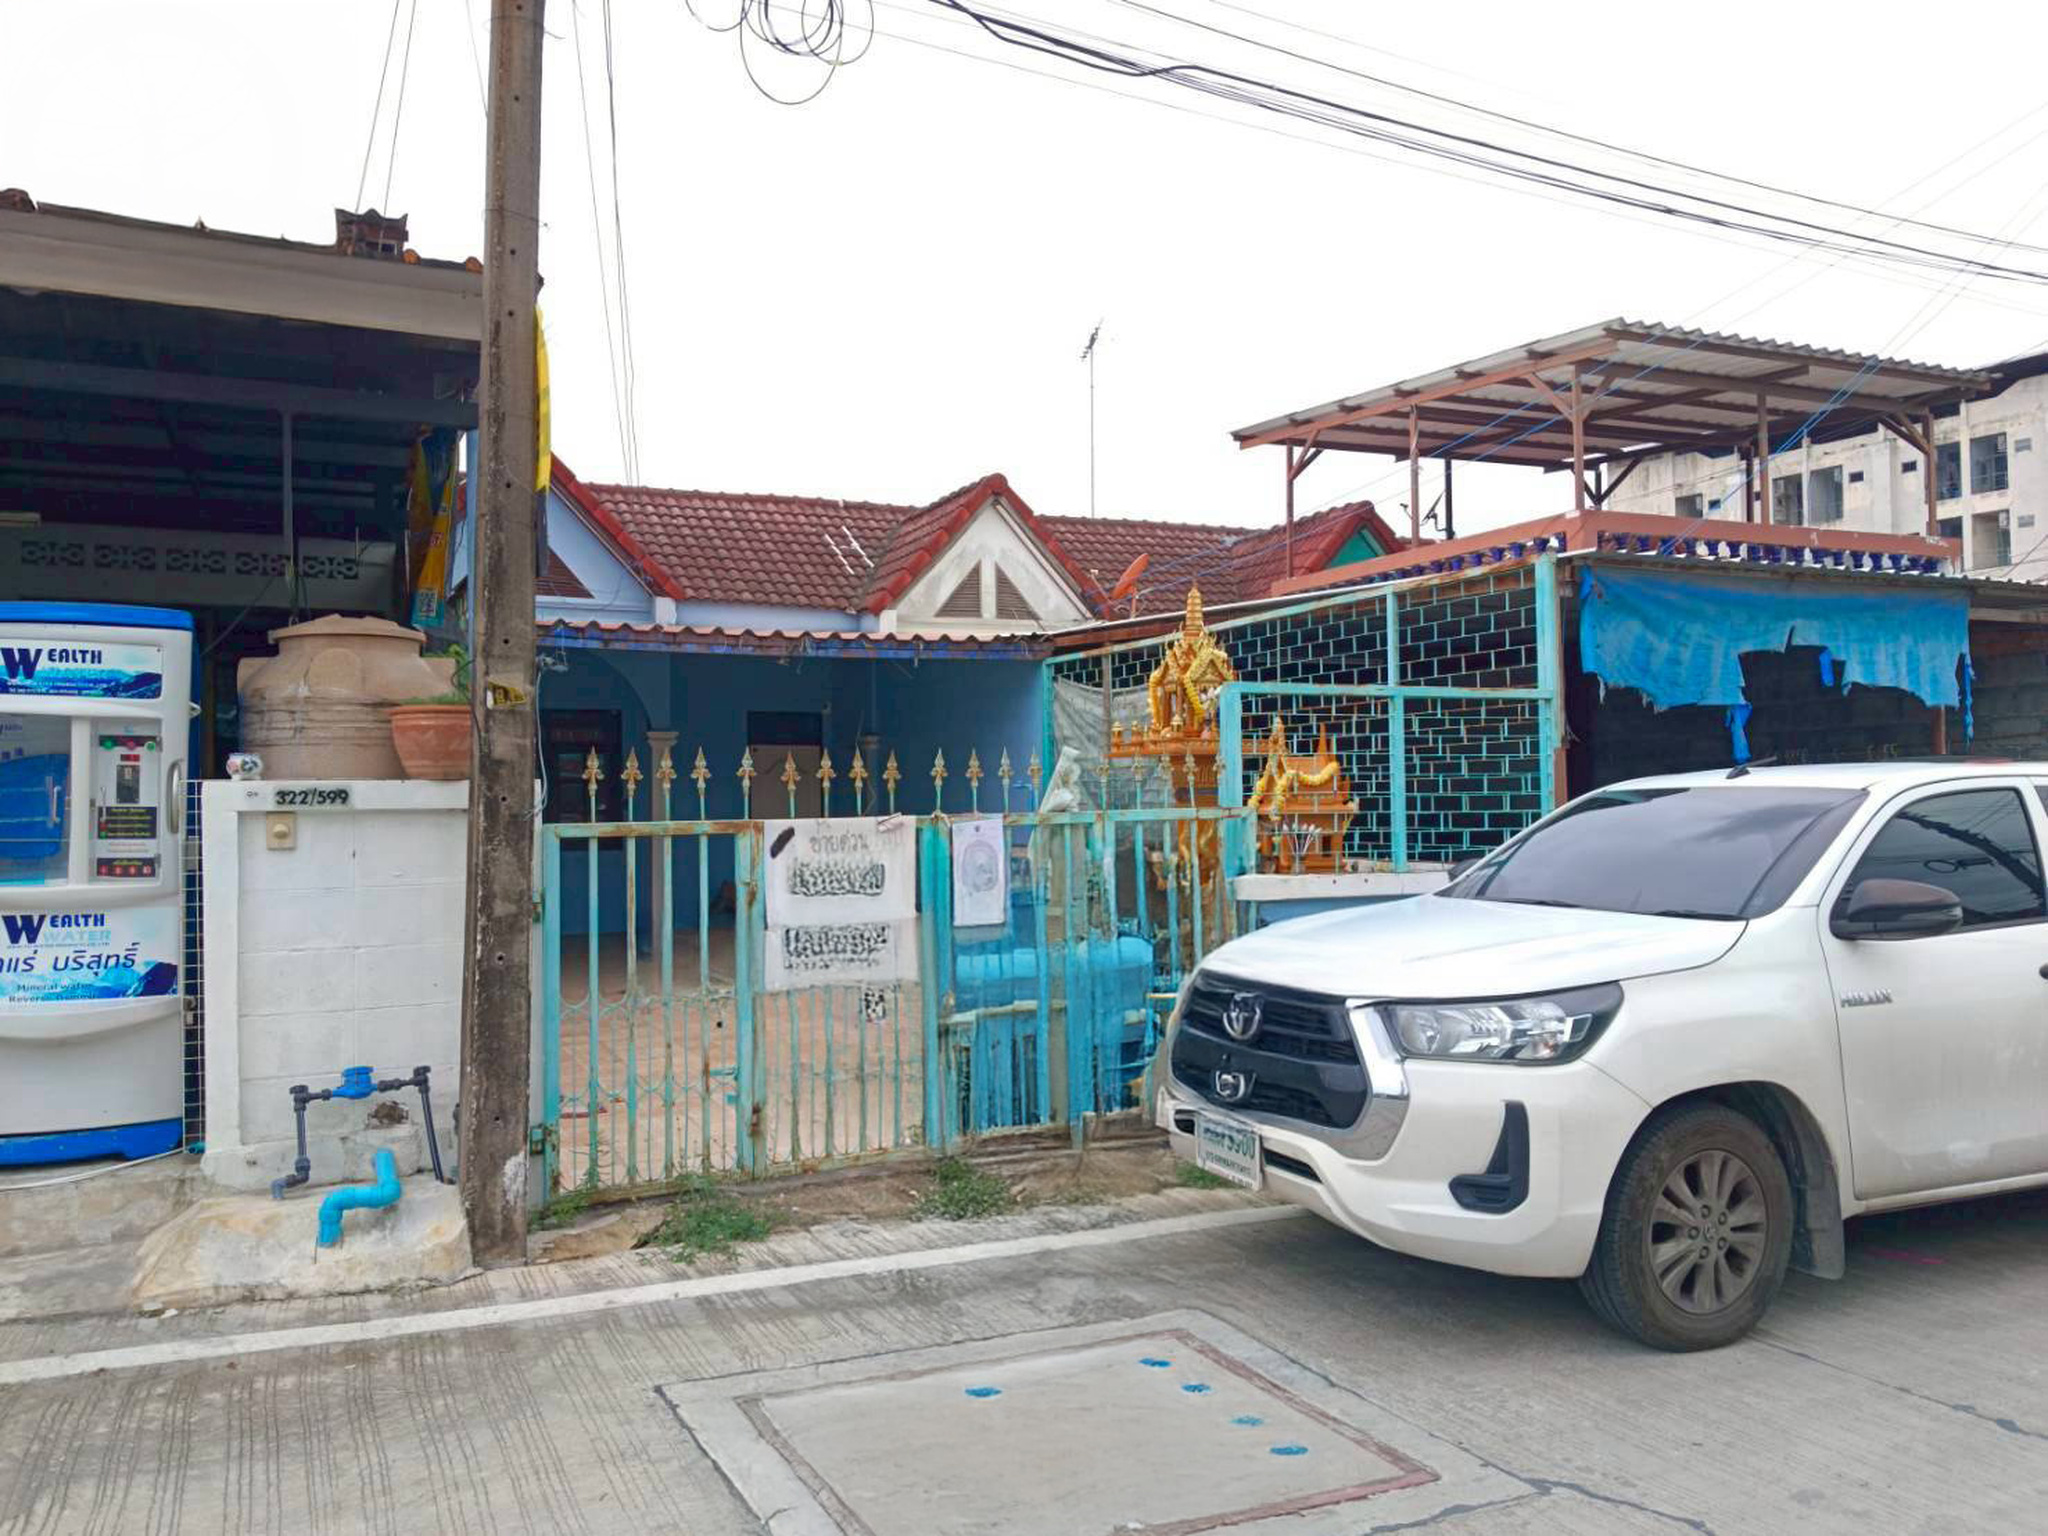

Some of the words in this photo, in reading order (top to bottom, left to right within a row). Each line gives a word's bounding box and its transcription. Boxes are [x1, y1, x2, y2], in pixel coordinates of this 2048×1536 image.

[0, 647, 102, 680] WEALTH
[275, 787, 350, 806] 322/599
[2, 913, 106, 945] WEALTH
[44, 930, 111, 943] WATER
[53, 942, 141, 977] บริสุทธิ์
